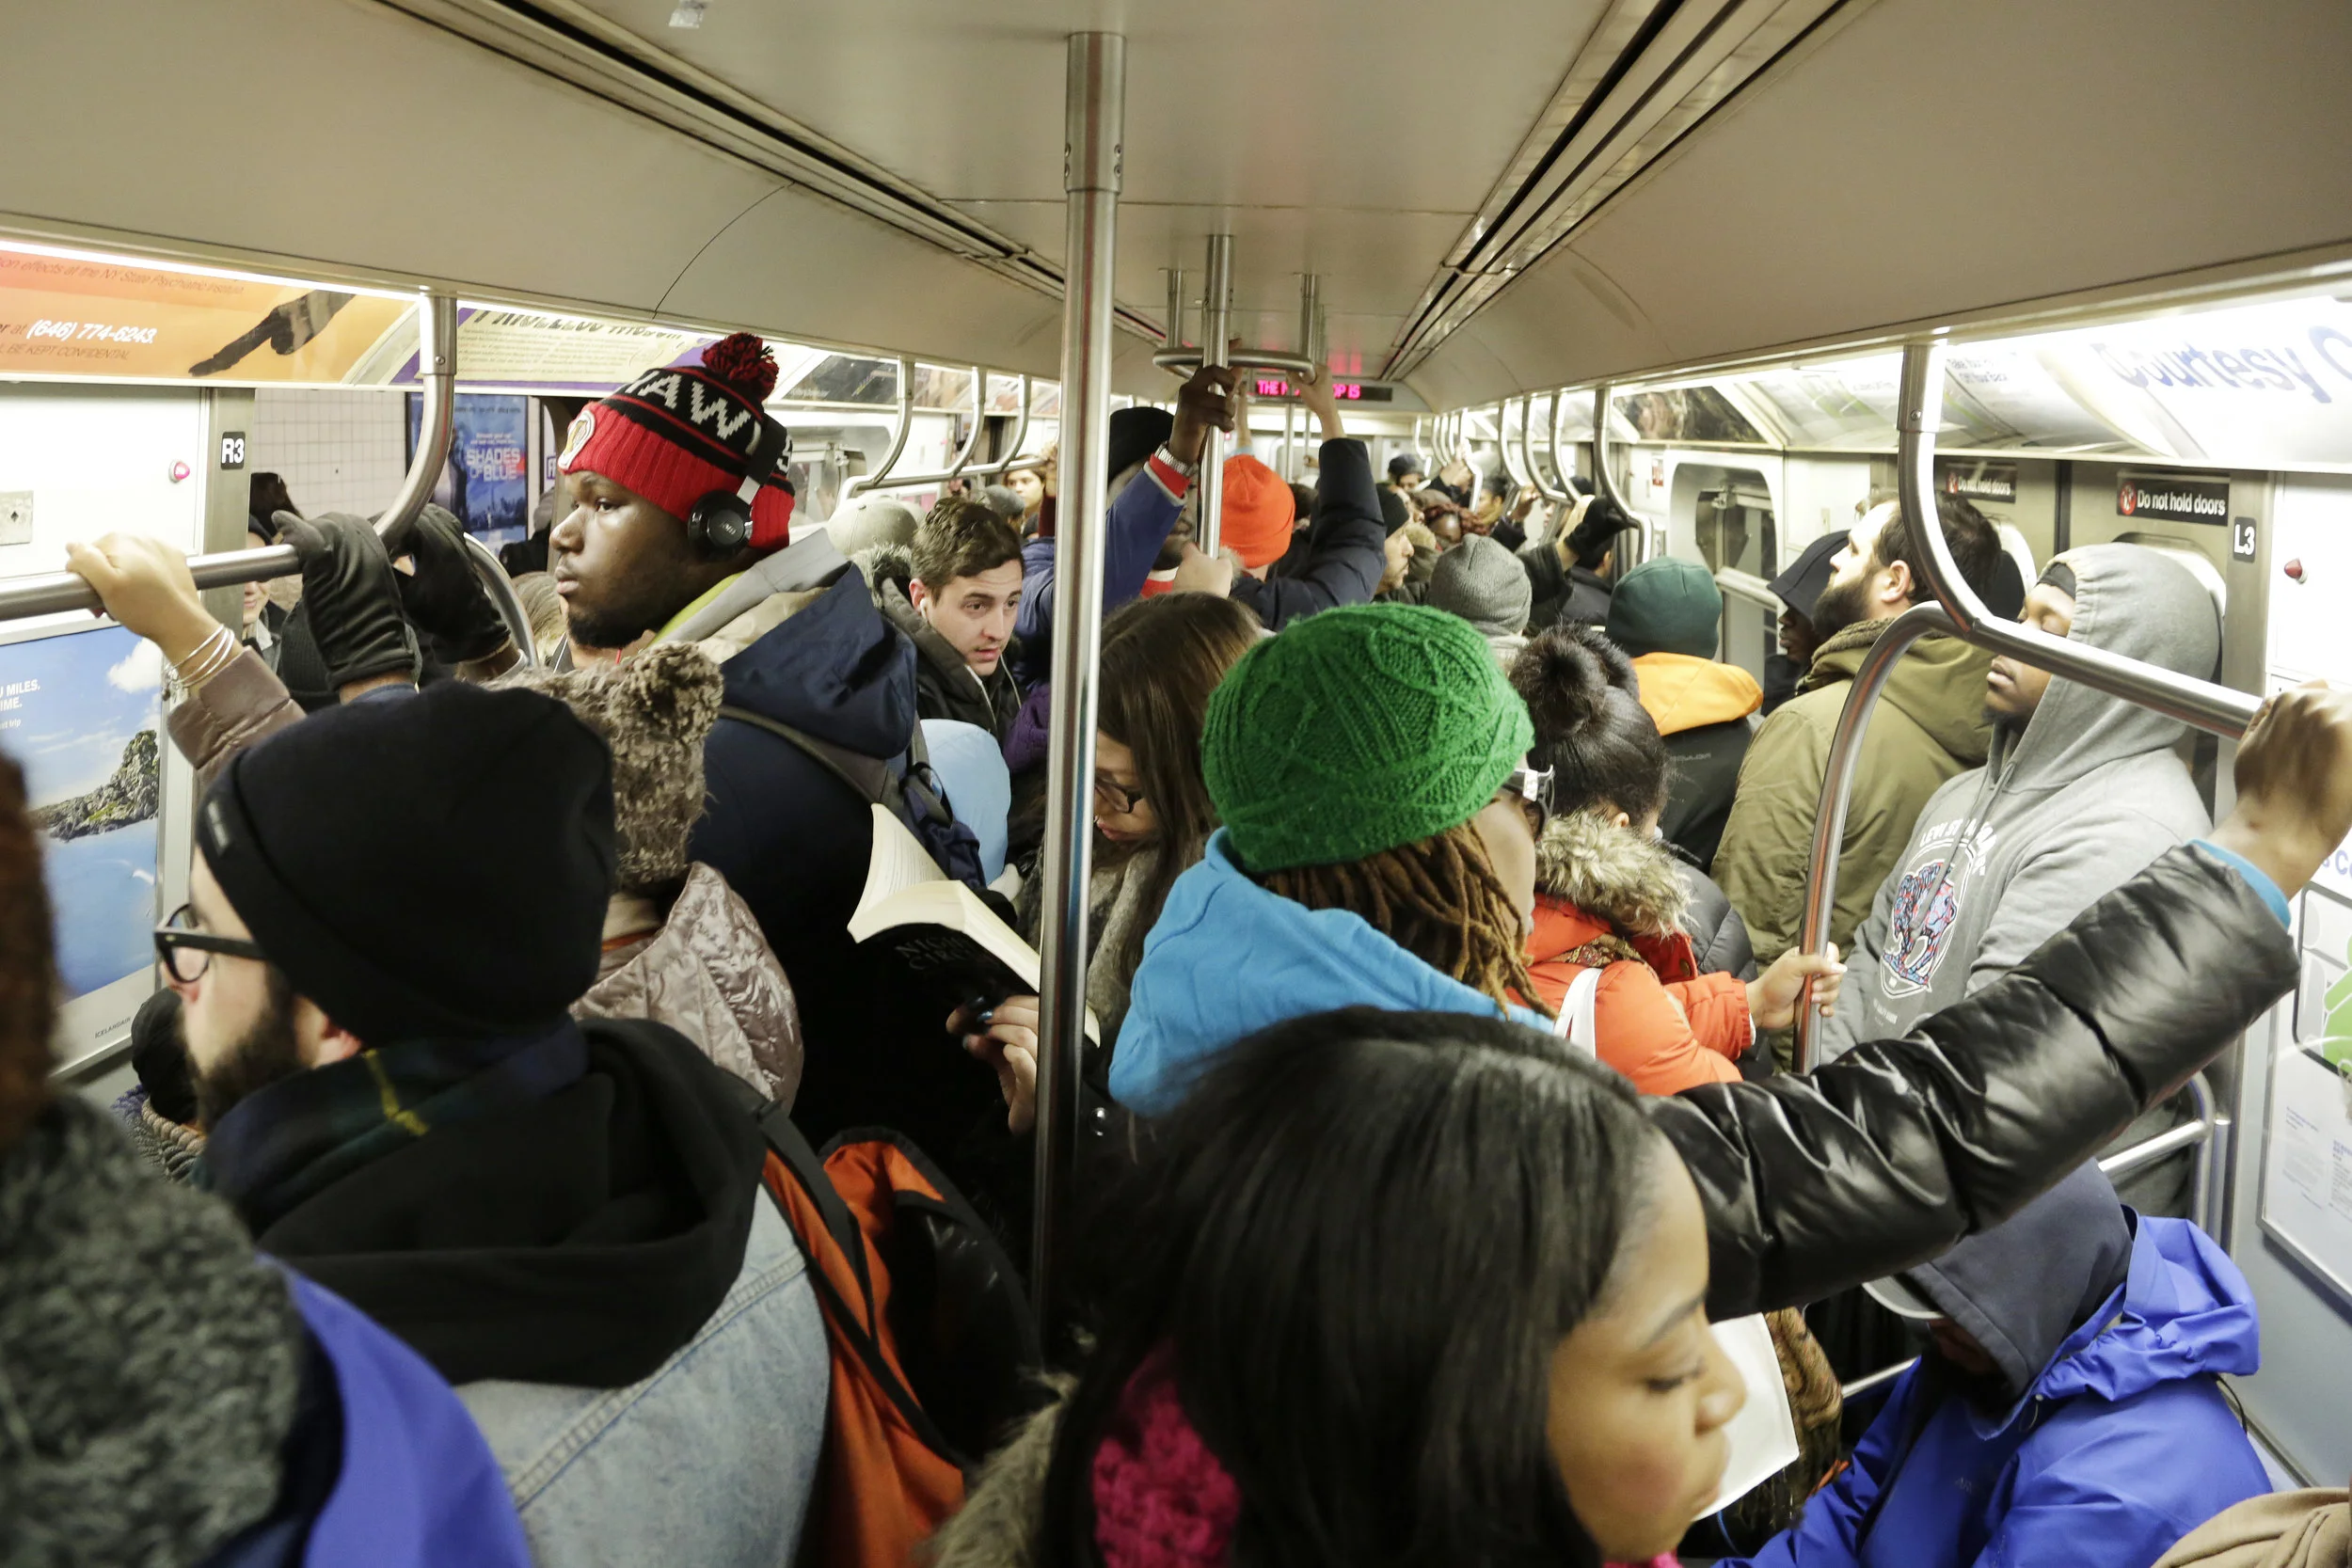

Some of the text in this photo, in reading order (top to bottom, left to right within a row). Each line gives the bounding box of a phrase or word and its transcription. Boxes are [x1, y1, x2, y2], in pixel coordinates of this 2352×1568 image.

[10, 323, 27, 335] at
[26, 319, 78, 341] (646)
[7, 343, 26, 355] BE
[25, 344, 58, 356] KEPT
[2090, 340, 2332, 404] Courtesy
[1257, 379, 1279, 396] THE
[1347, 384, 1360, 400] IS
[221, 437, 245, 464] R3
[466, 447, 520, 467] SHADES
[483, 464, 518, 483] BLUE
[2137, 489, 2226, 516] Do not hold doors
[2233, 524, 2255, 556] L3
[6, 678, 40, 697] MILES.
[0, 695, 23, 712] IME.
[1919, 821, 1948, 848] LEVI
[94, 1016, 132, 1039] ICELANDAIR
